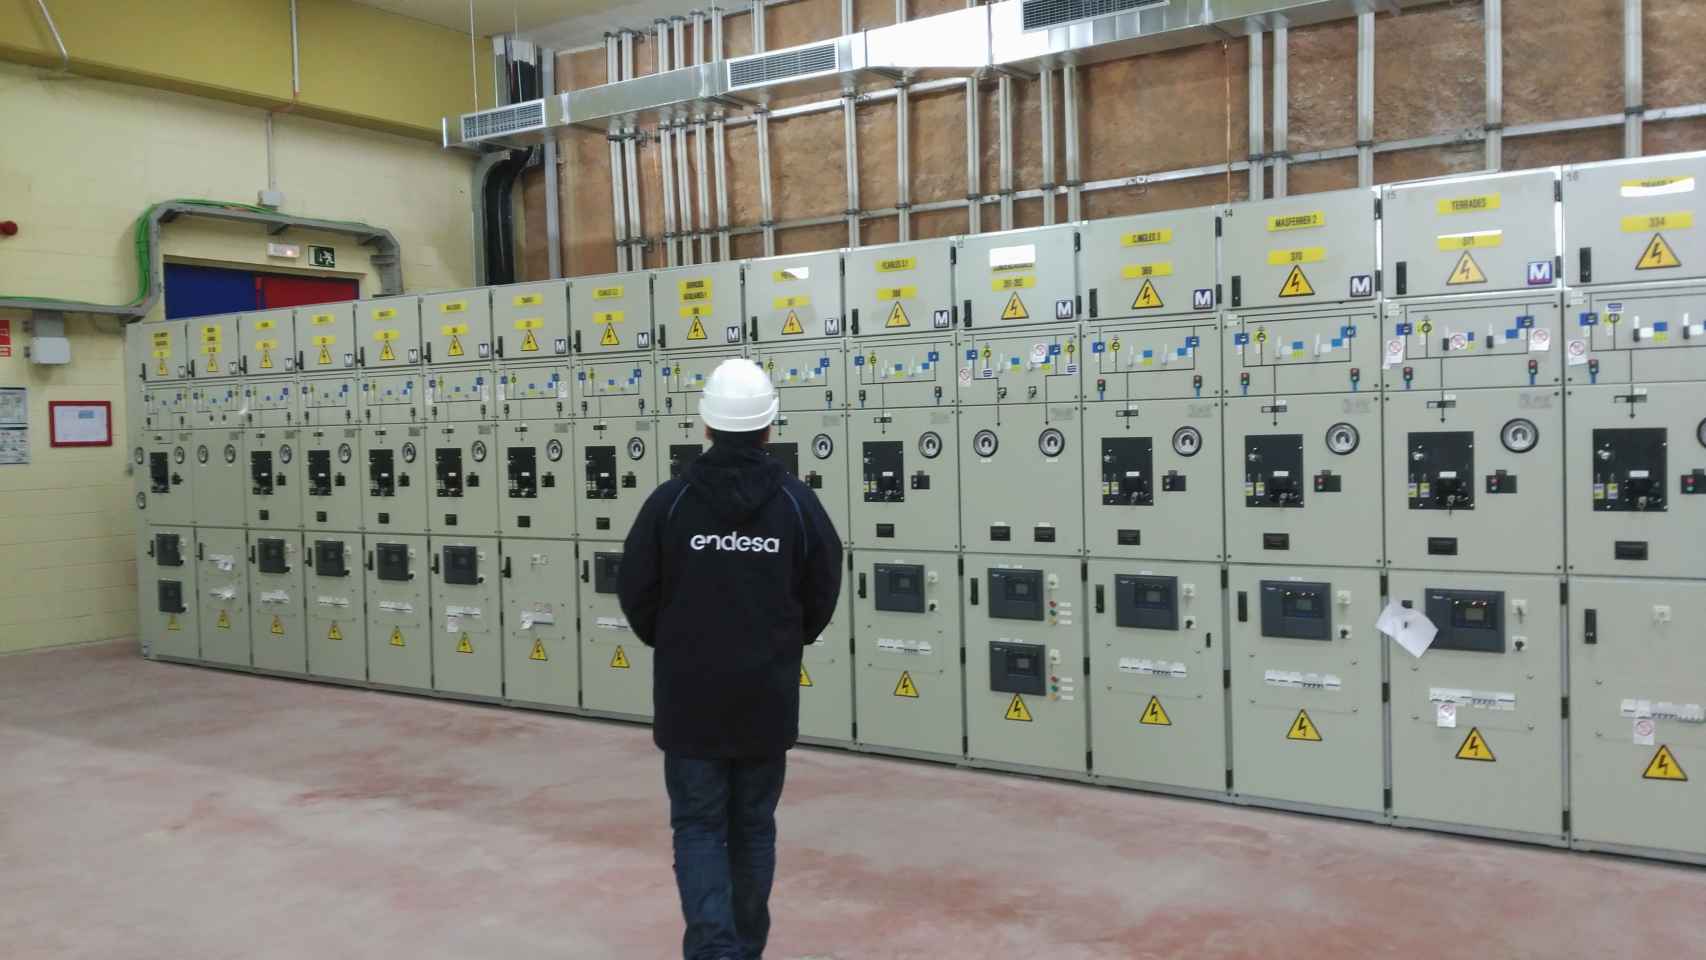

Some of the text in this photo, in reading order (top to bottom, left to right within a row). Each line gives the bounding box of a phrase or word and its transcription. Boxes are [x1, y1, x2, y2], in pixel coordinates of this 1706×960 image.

[1451, 197, 1488, 212] TERRADES
[1224, 208, 1233, 217] 14
[1530, 263, 1550, 280] M
[1352, 277, 1370, 293] M
[1194, 290, 1211, 305] M
[1057, 302, 1072, 316] M
[935, 311, 948, 325] M
[826, 319, 838, 332] M
[639, 334, 648, 344] M
[728, 327, 739, 339] M
[556, 341, 565, 352] M
[690, 531, 780, 553] endesa
